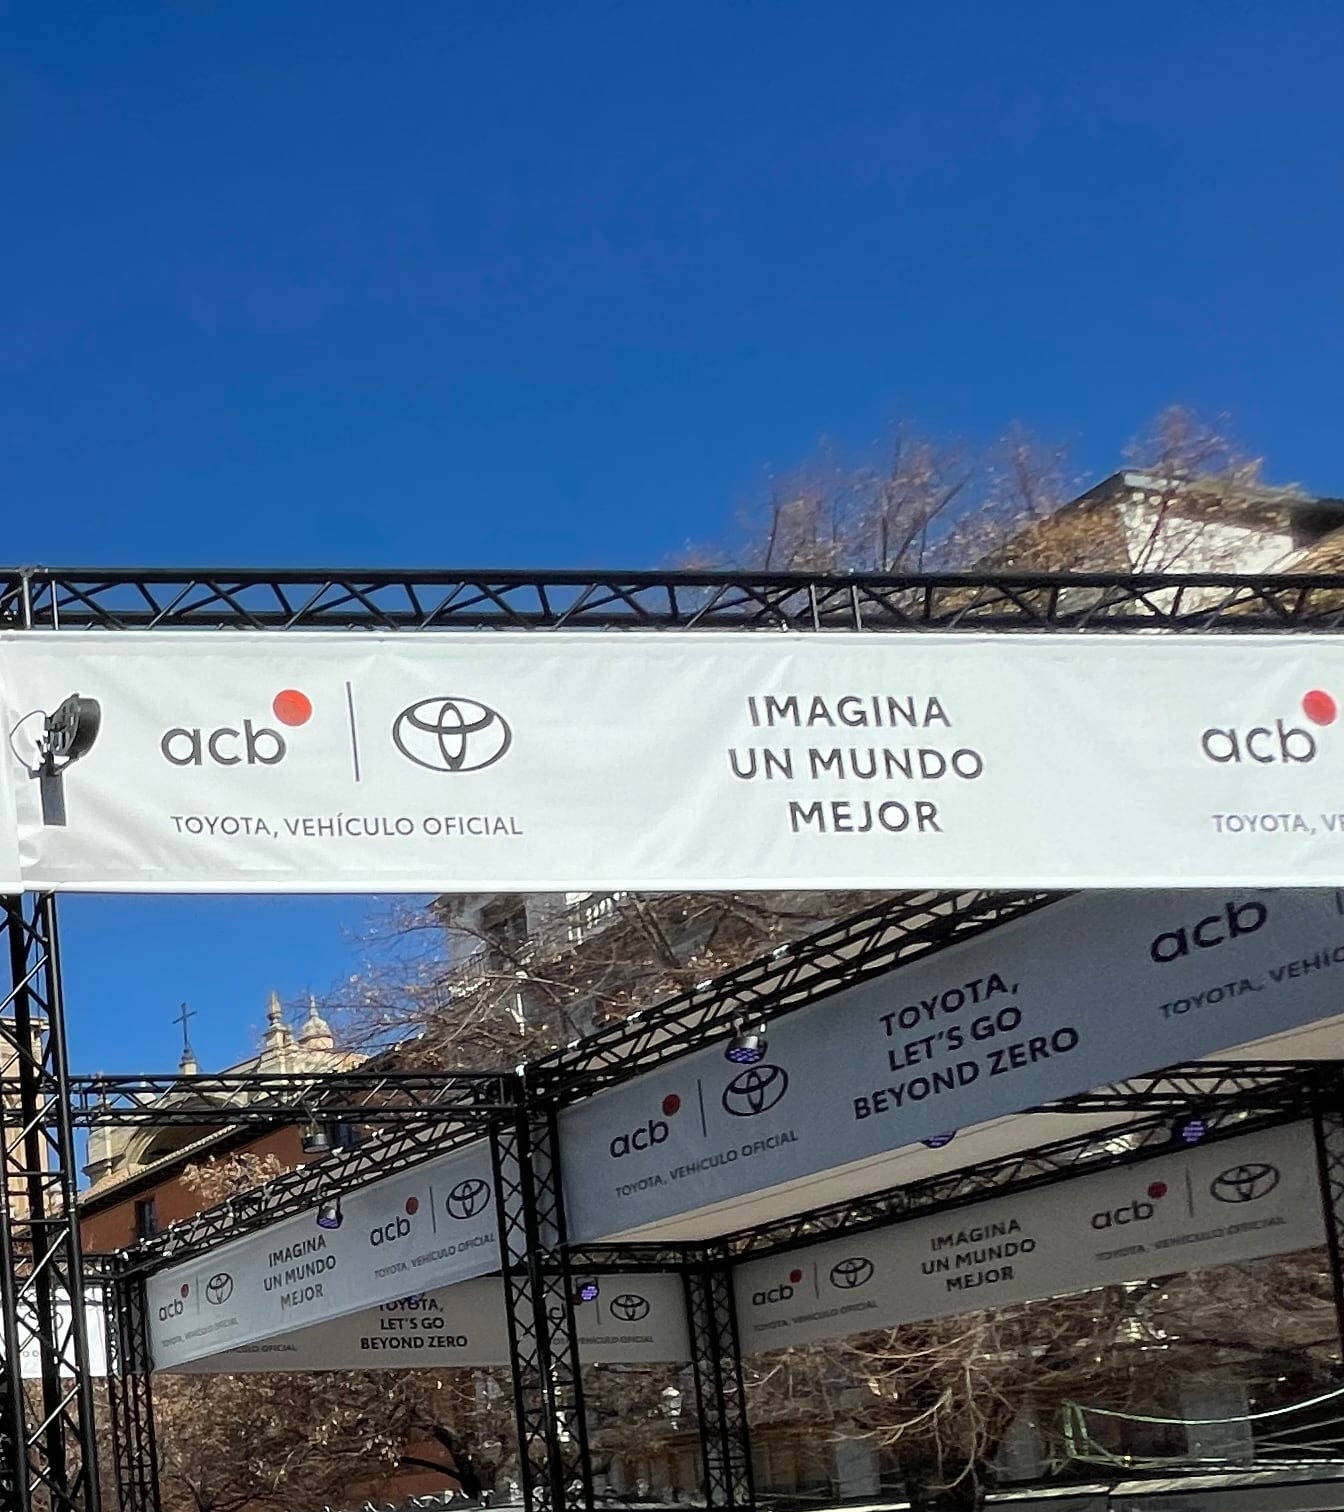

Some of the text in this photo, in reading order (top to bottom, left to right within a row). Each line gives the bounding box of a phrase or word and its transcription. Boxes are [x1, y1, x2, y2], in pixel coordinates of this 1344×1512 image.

[747, 694, 952, 729] IMAGINA
[161, 718, 287, 767] acb
[1201, 718, 1317, 764] acb
[728, 747, 984, 781] UN MUNDO
[171, 812, 524, 838] TOYOTA, VEHÍCULO OFICIAL
[788, 800, 944, 833] MEJOR
[1212, 813, 1317, 836] TOYOTA,
[1150, 901, 1268, 963] acb
[879, 973, 1021, 1036] TOYOTA,
[1159, 978, 1264, 1020] TOYOTA,
[888, 1006, 1022, 1071] LET'S GO
[853, 1027, 1080, 1120] BEYOND ZERO
[609, 1119, 669, 1158] acb
[741, 1130, 799, 1157] OFICIAL
[370, 1216, 411, 1246] acb
[1091, 1200, 1154, 1230] acb
[268, 1233, 327, 1268] IMAGINA
[930, 1219, 1022, 1251] IMAGINA
[921, 1238, 1037, 1275] UN MUNDO
[264, 1255, 337, 1292] UN MUNDO
[946, 1266, 1015, 1293] MEJOR
[159, 1299, 184, 1321] acb
[280, 1283, 324, 1310] MEJOR
[752, 1283, 794, 1306] acb
[380, 1317, 445, 1330] LET'S GO
[360, 1335, 468, 1349] BEYOND ZERO
